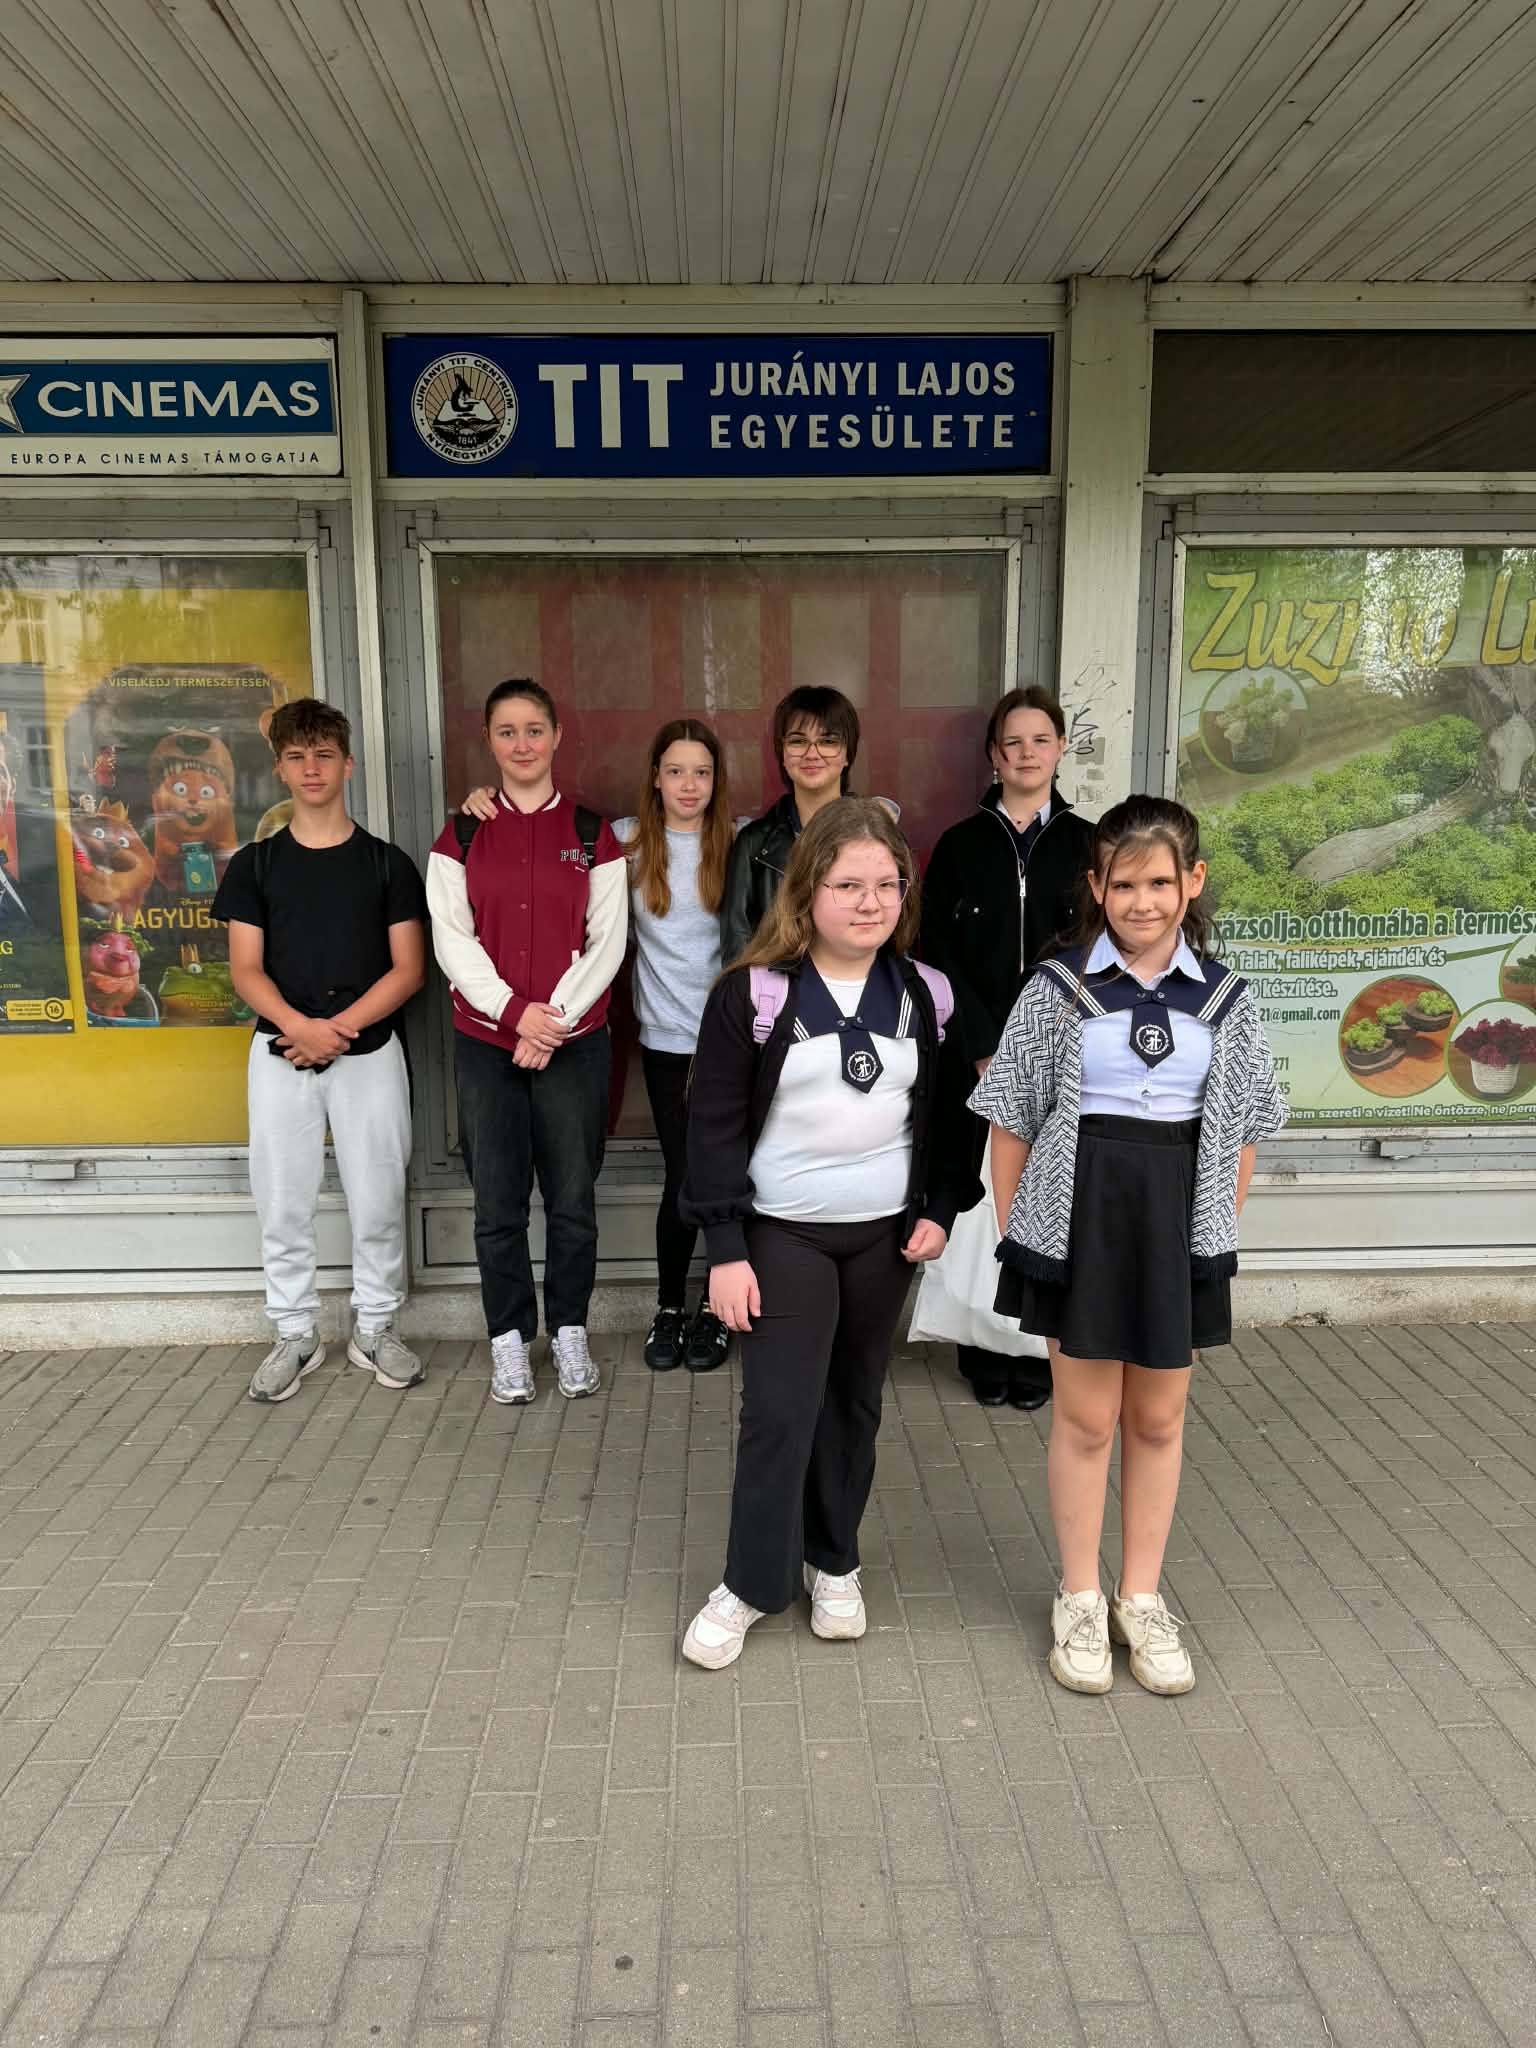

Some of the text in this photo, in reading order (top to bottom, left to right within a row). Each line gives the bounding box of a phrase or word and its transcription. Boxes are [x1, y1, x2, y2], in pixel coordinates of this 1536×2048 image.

[449, 358, 466, 366] TIT
[474, 359, 514, 409] CENTRUM
[710, 351, 1015, 396] JURÁNYI LAJOS
[38, 380, 321, 418] CINEMAS
[538, 363, 684, 448] TIT
[710, 405, 1014, 449] EGYESÜLETE
[11, 450, 320, 465] EUROPA CINEMAS TÁMOGATJA
[1207, 906, 1536, 943] rázsolja otthonába a termés
[1239, 950, 1281, 972] falak,
[1285, 948, 1361, 971] faliképek,
[1364, 946, 1426, 970] ajándék
[1428, 946, 1447, 968] és
[1262, 977, 1338, 998] készítése.
[49, 1005, 61, 1015] 16
[1259, 1007, 1341, 1023] 21@gmail.com
[1319, 1106, 1361, 1119] szereti
[1364, 1107, 1374, 1118] a
[1414, 1104, 1432, 1116] Ne
[1491, 1104, 1507, 1115] ne
